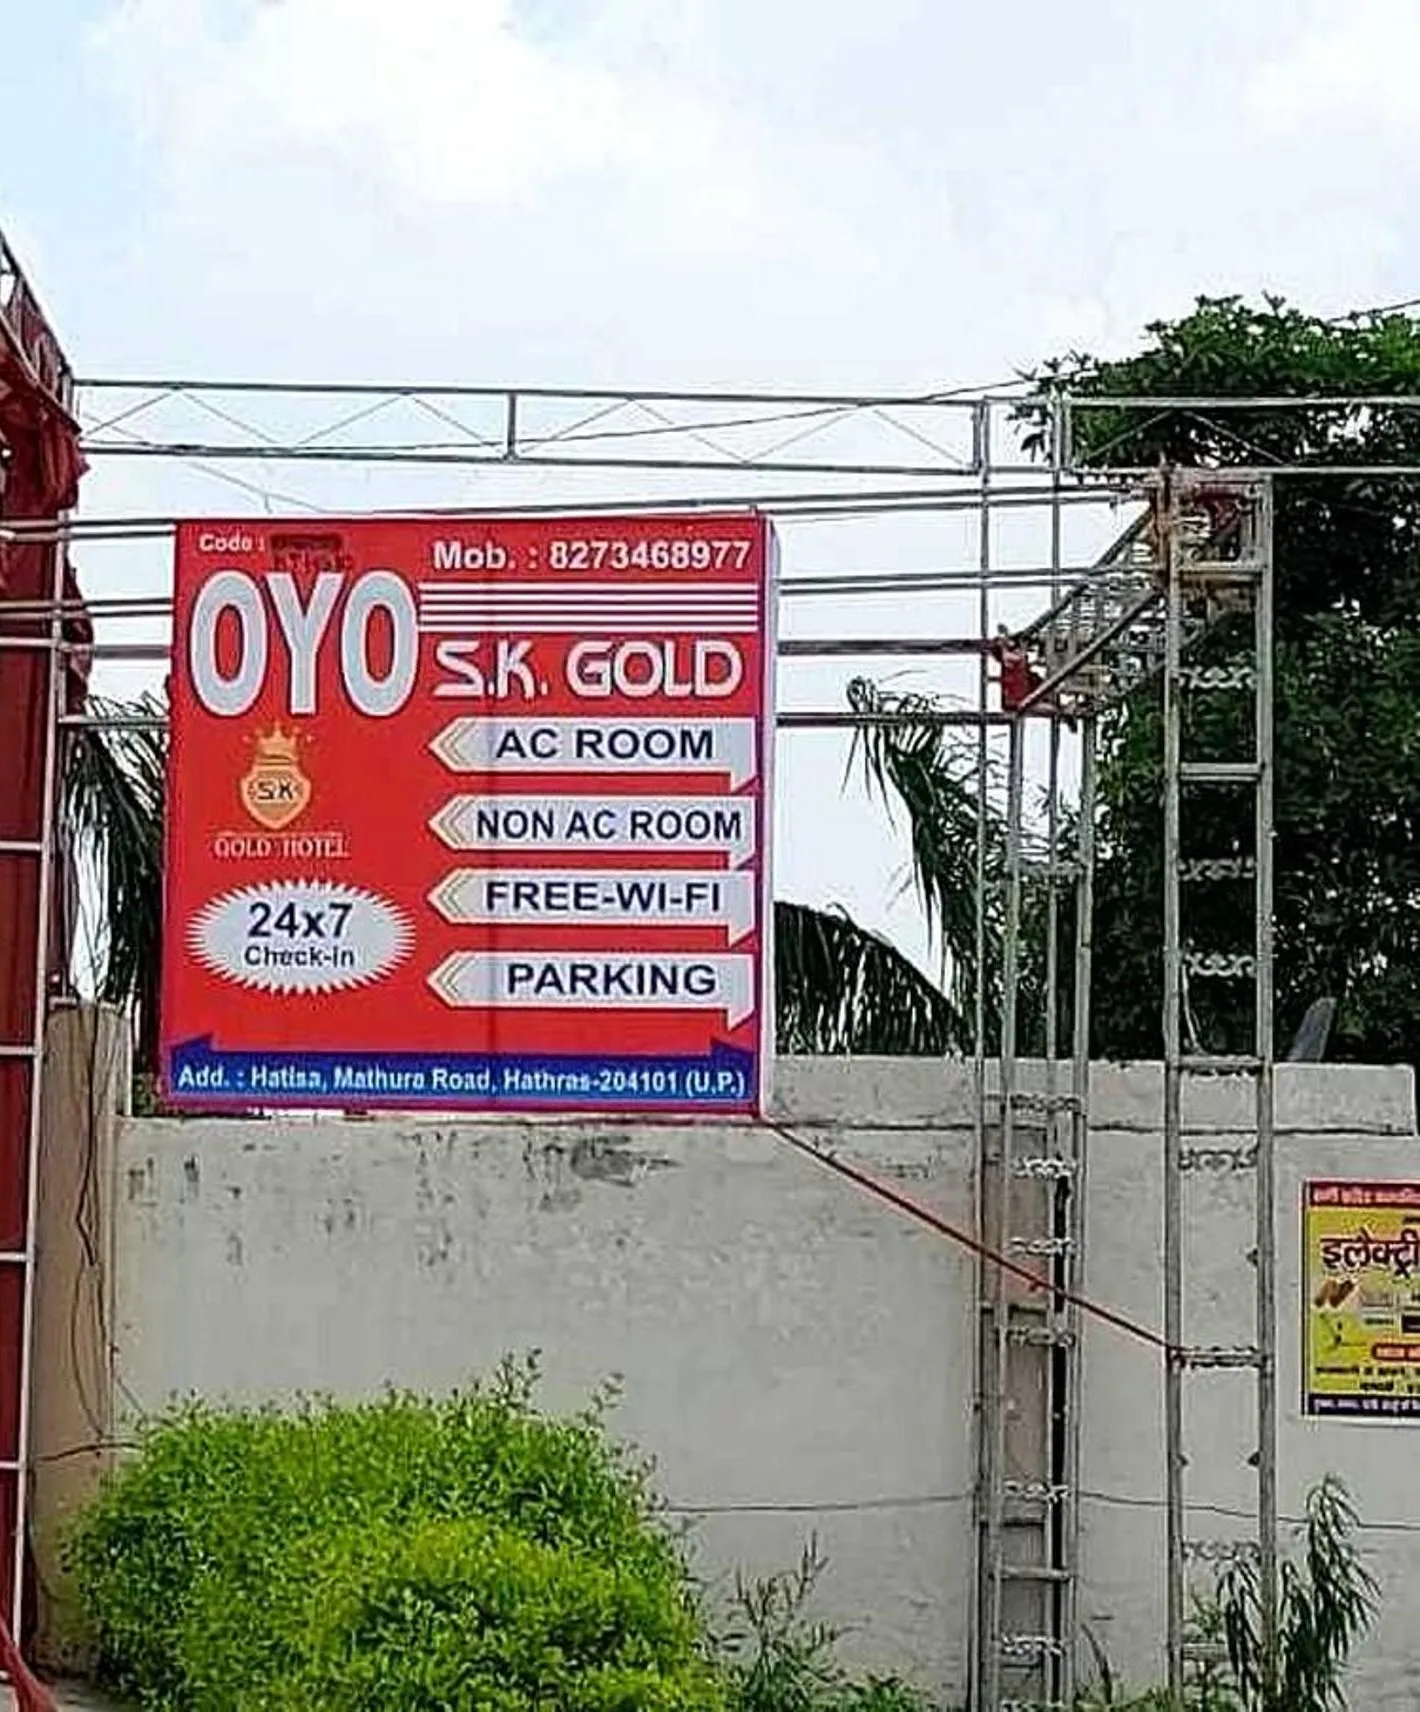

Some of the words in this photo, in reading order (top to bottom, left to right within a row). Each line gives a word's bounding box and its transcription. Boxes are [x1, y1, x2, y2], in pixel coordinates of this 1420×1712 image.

[199, 531, 253, 551] Code
[433, 540, 516, 569] Mob.
[550, 541, 751, 569] 8273468977
[190, 570, 419, 717] OYO
[433, 639, 548, 698] S.K.
[566, 639, 744, 697] GOLD
[495, 730, 562, 760] AC
[576, 729, 714, 760] ROOM
[476, 808, 554, 839] NON
[565, 809, 616, 839] AC
[630, 809, 742, 840] ROOM
[486, 881, 721, 912] FREE-WI-FI
[248, 902, 353, 938] 24x7
[507, 963, 717, 995] PARKING
[179, 1065, 230, 1087] Add.
[333, 1066, 424, 1090] Mathura
[432, 1067, 497, 1092] Road,
[685, 1070, 745, 1097] (U.P.)
